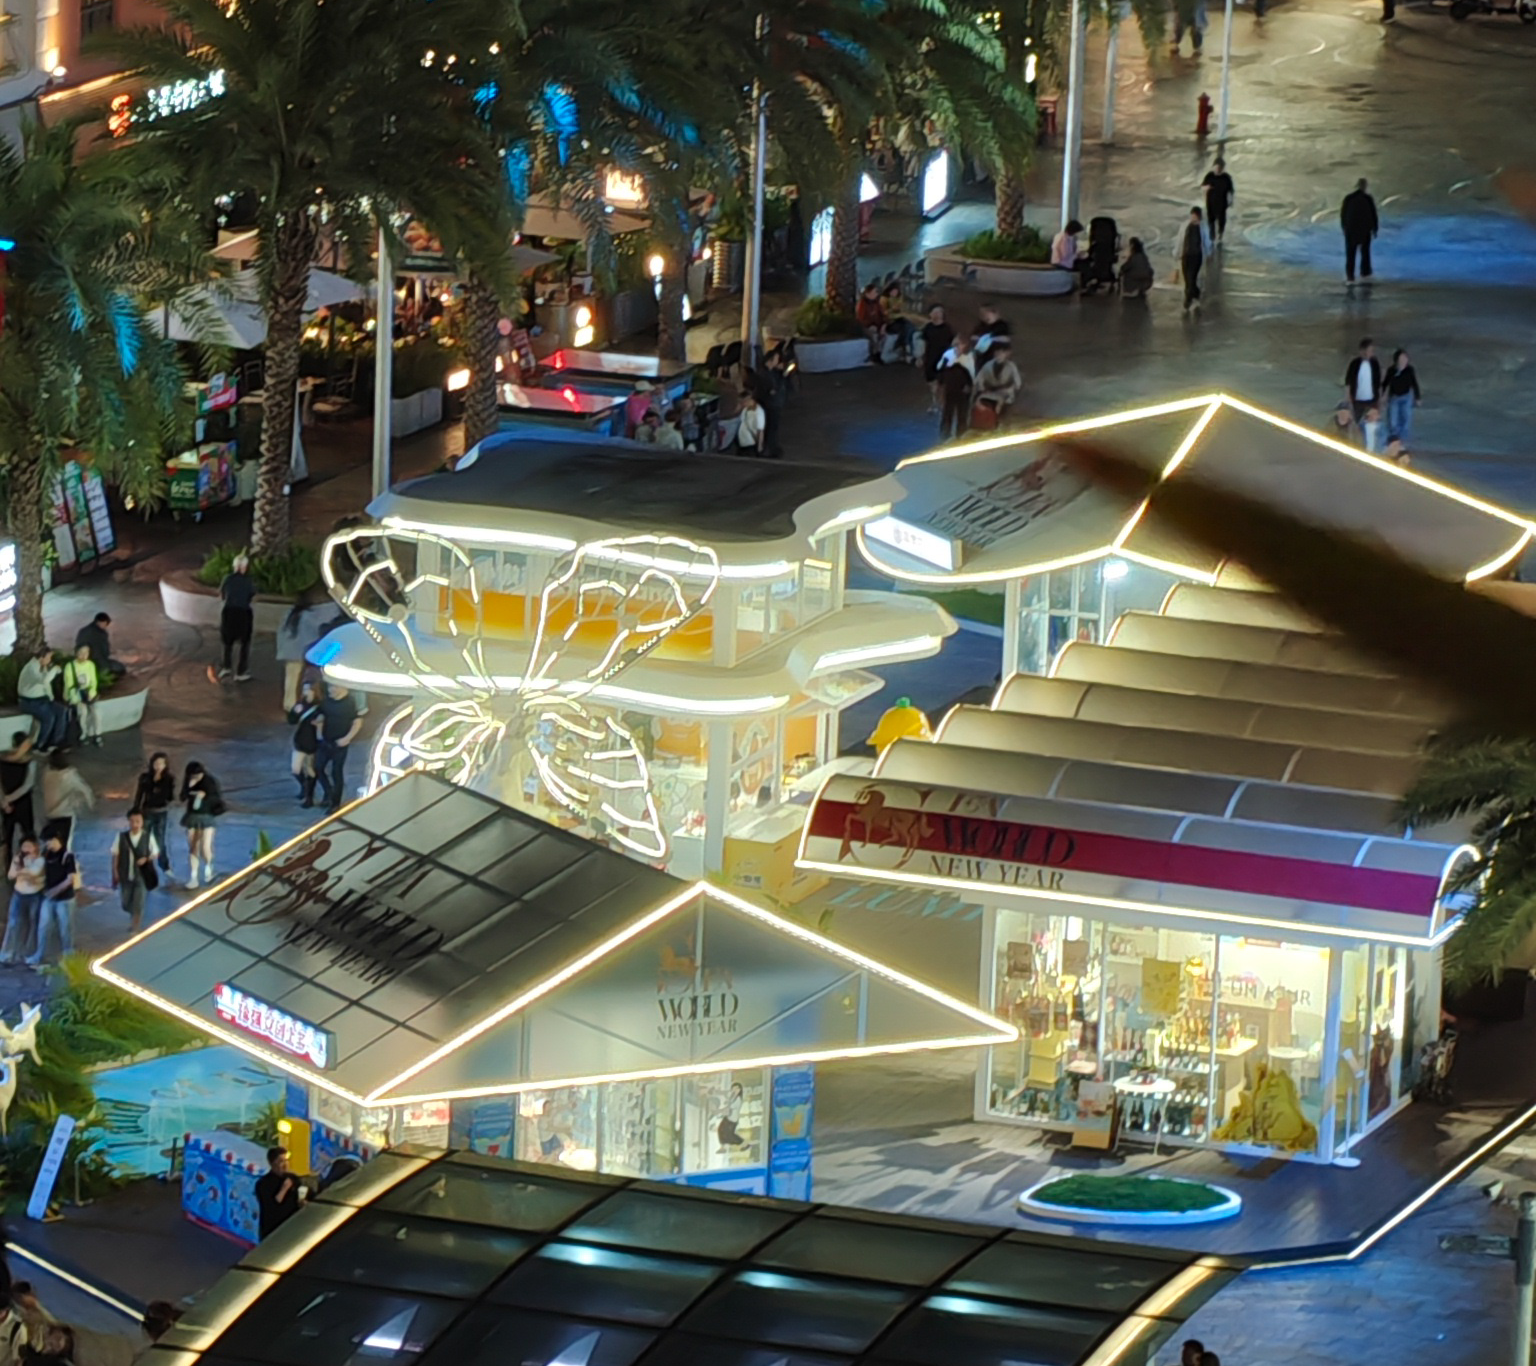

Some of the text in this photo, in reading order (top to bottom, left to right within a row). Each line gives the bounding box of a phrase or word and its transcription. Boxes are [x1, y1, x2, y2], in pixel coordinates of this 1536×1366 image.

[930, 854, 1066, 891] NEW YEAR
[657, 992, 739, 1023] WORLD
[656, 1018, 738, 1040] NEW YEAR
